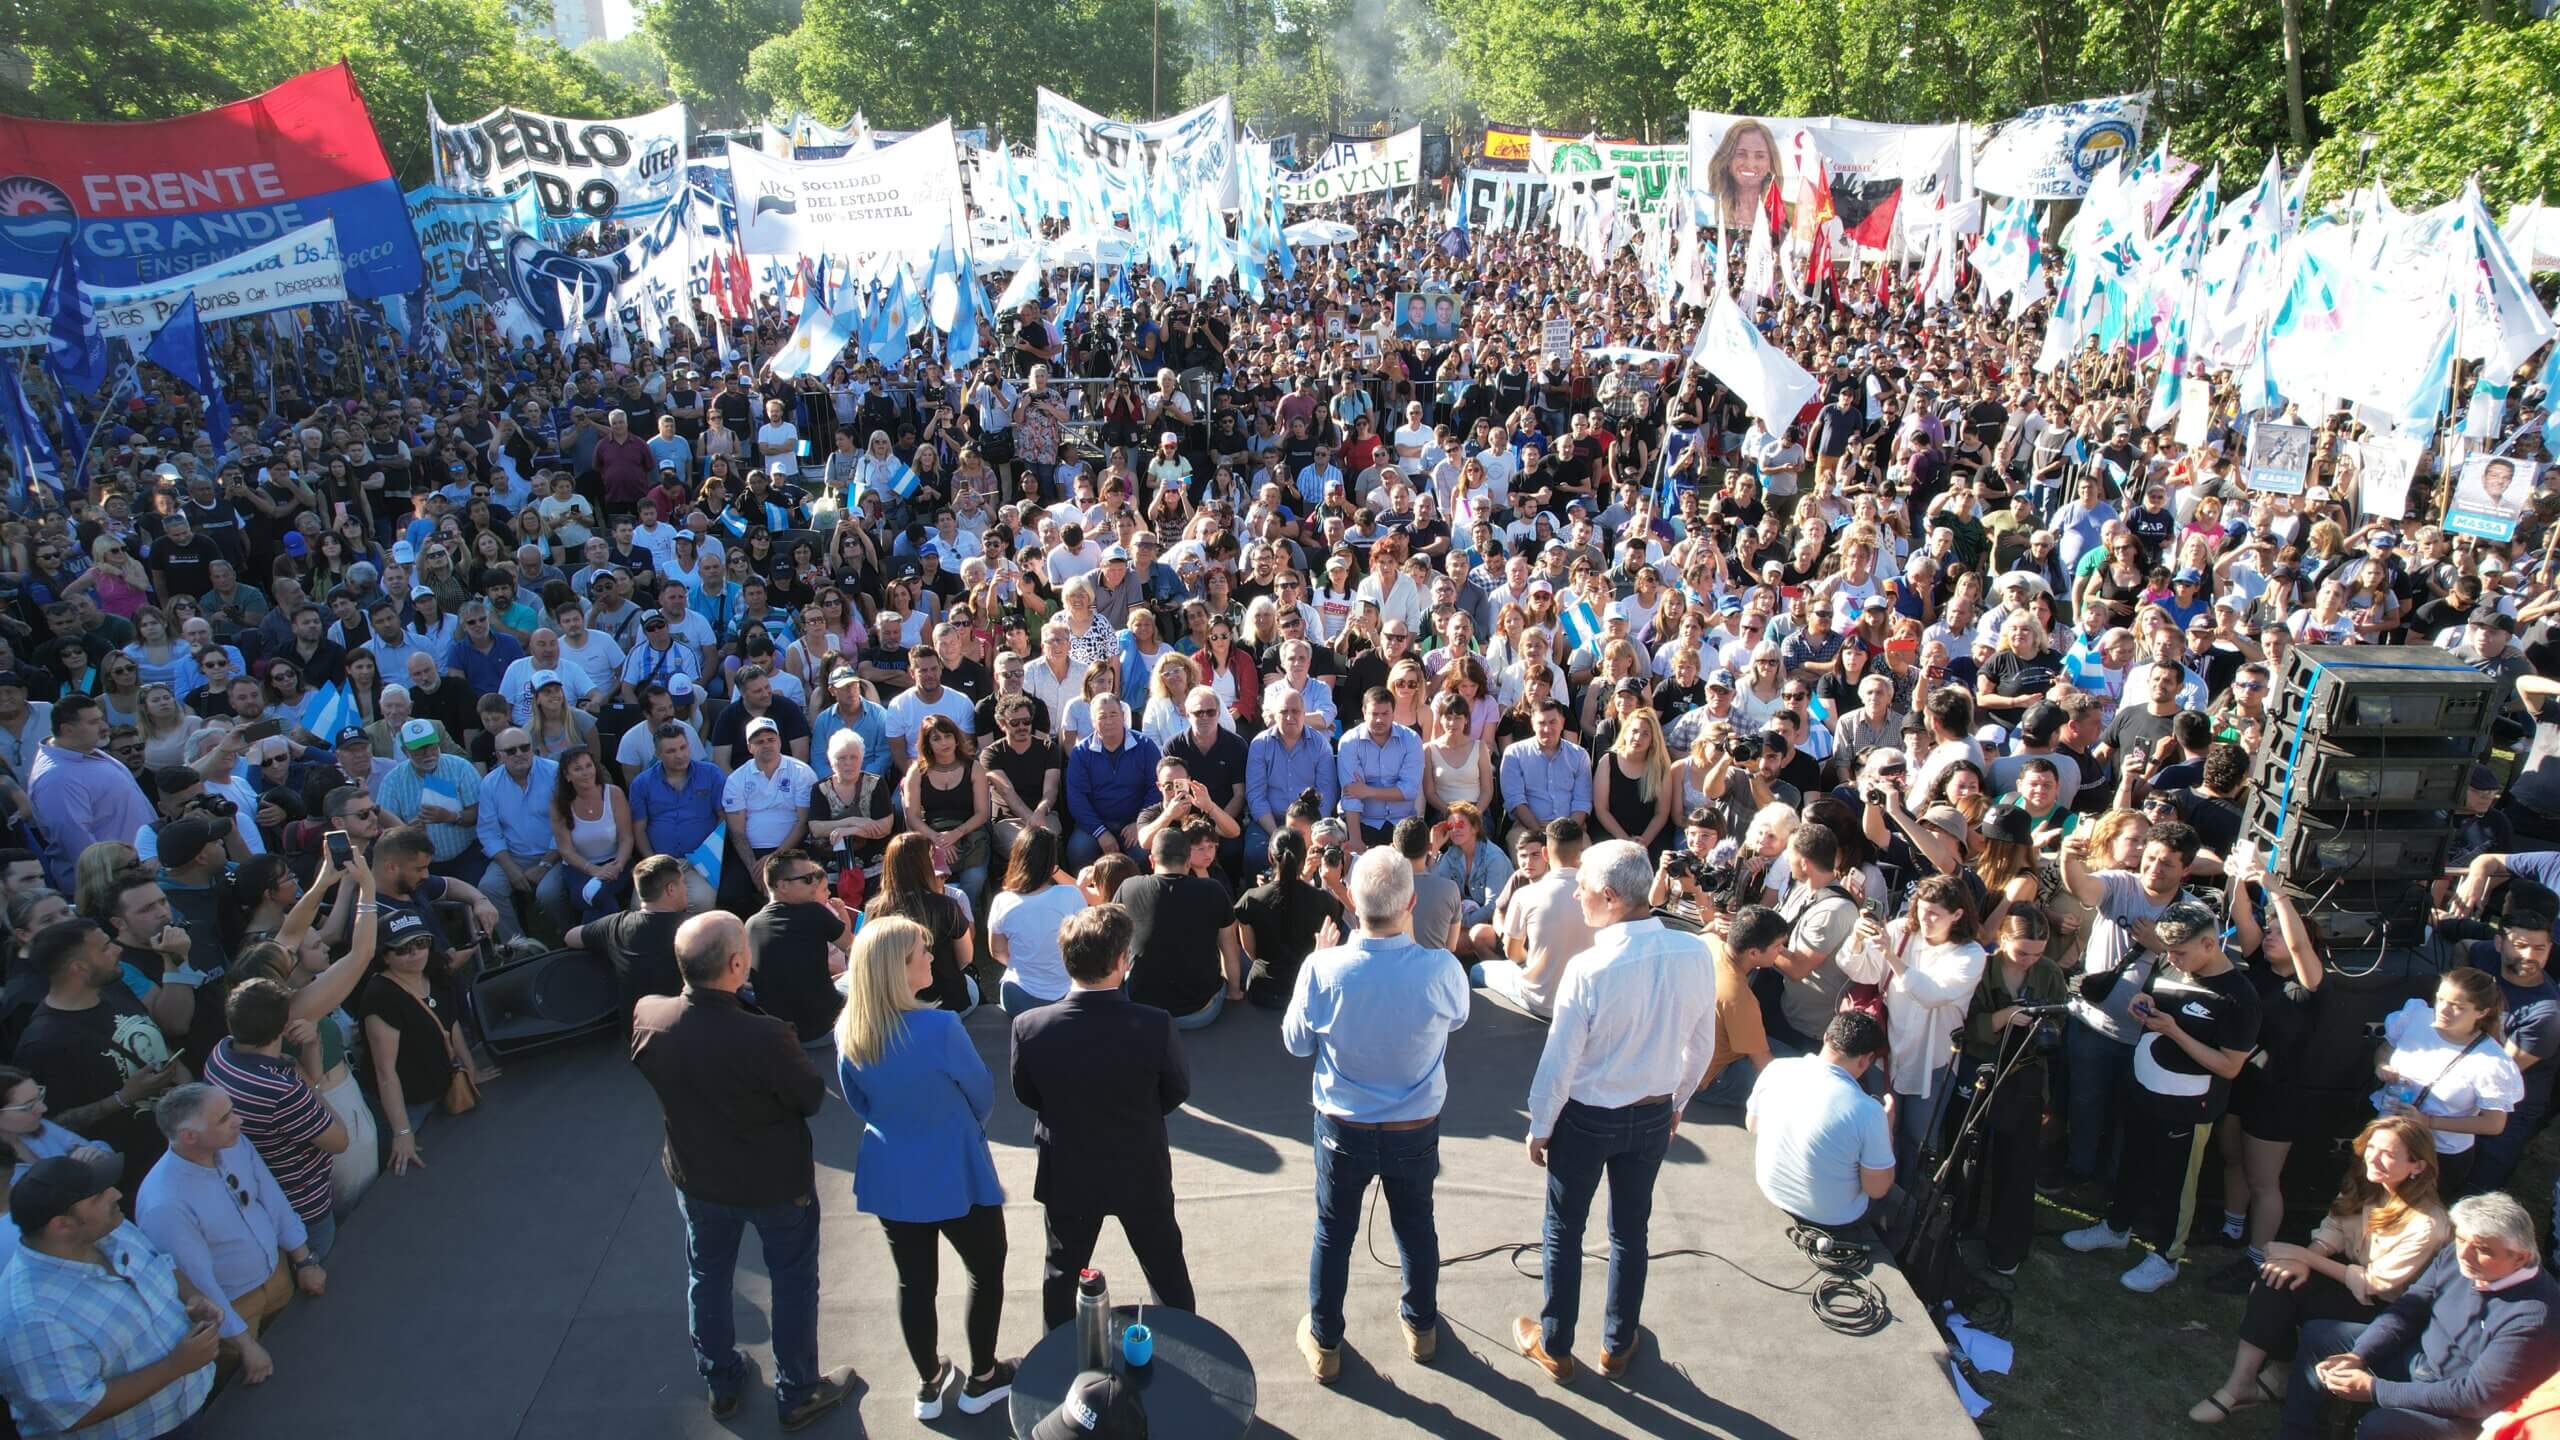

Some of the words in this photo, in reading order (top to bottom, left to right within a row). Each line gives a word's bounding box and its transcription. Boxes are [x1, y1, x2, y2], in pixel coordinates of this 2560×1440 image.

[639, 143, 679, 179] UTEP
[82, 162, 286, 212] FRENTE
[802, 174, 882, 192] SOCIEDAD
[1337, 159, 1412, 193] VIVE
[807, 197, 836, 208] DEL
[840, 189, 900, 206] ESTADO
[848, 206, 913, 221] ESTATAL
[84, 202, 304, 257] GRANDE
[2456, 517, 2502, 533] MASSA
